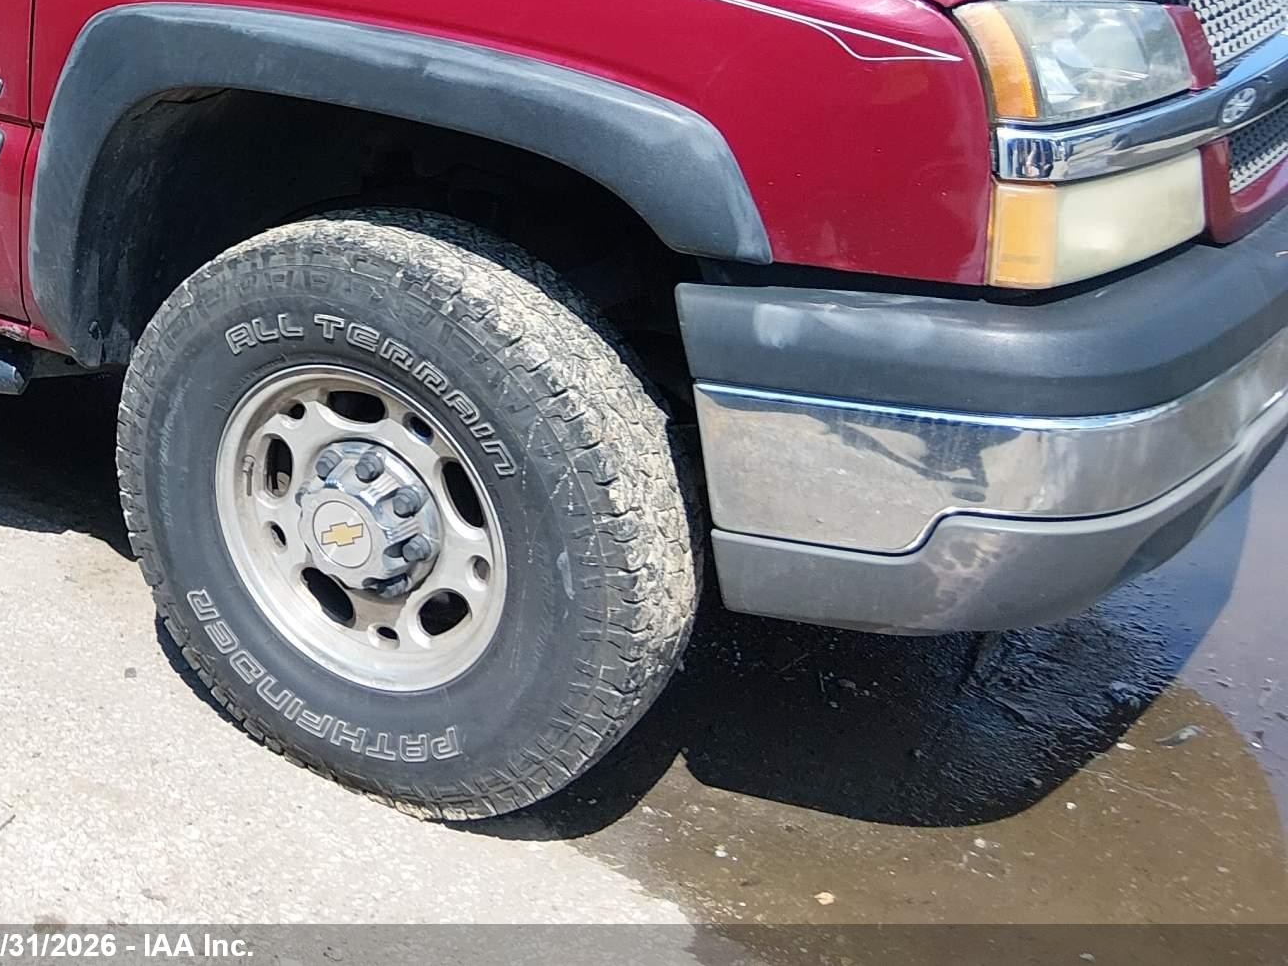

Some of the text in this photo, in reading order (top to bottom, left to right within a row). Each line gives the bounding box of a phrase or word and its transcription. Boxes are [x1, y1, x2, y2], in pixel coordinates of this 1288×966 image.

[224, 313, 304, 355] ALL
[314, 313, 517, 476] TERRAIN
[187, 588, 462, 763] PATHFINDER
